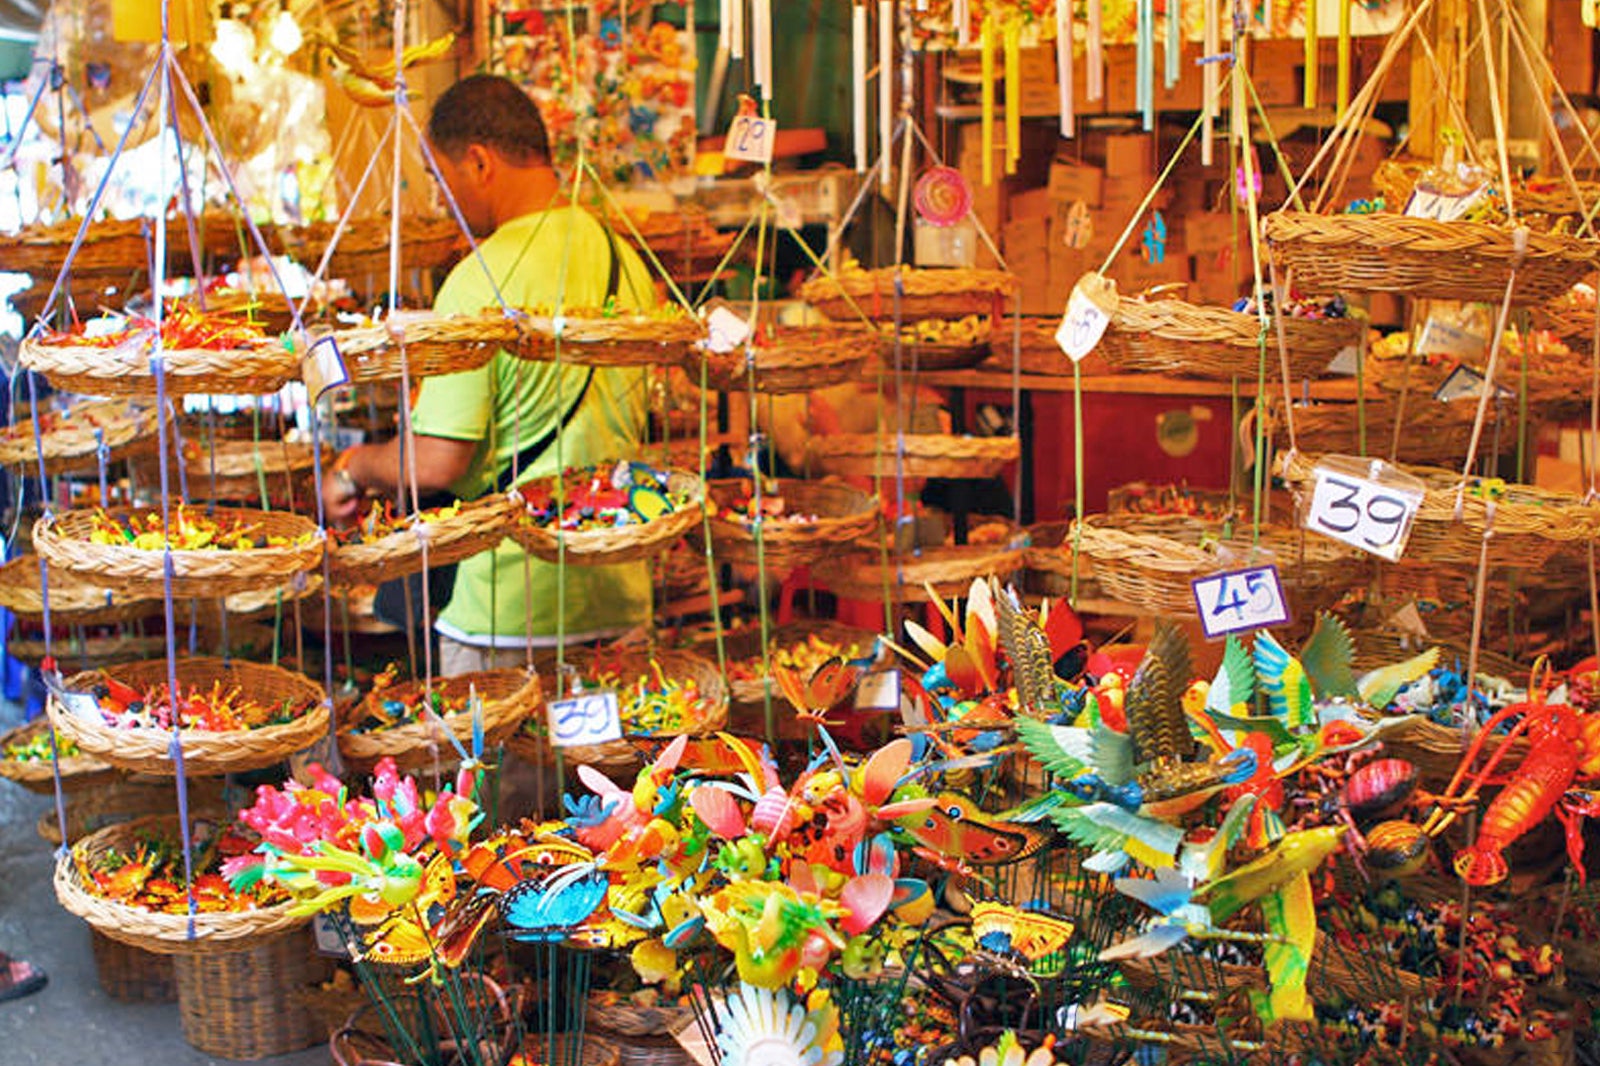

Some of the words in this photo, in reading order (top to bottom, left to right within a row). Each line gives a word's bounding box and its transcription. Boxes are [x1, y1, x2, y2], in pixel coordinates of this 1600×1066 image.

[1318, 478, 1406, 548] 39
[1212, 572, 1275, 620] 45
[553, 694, 610, 738] 39
